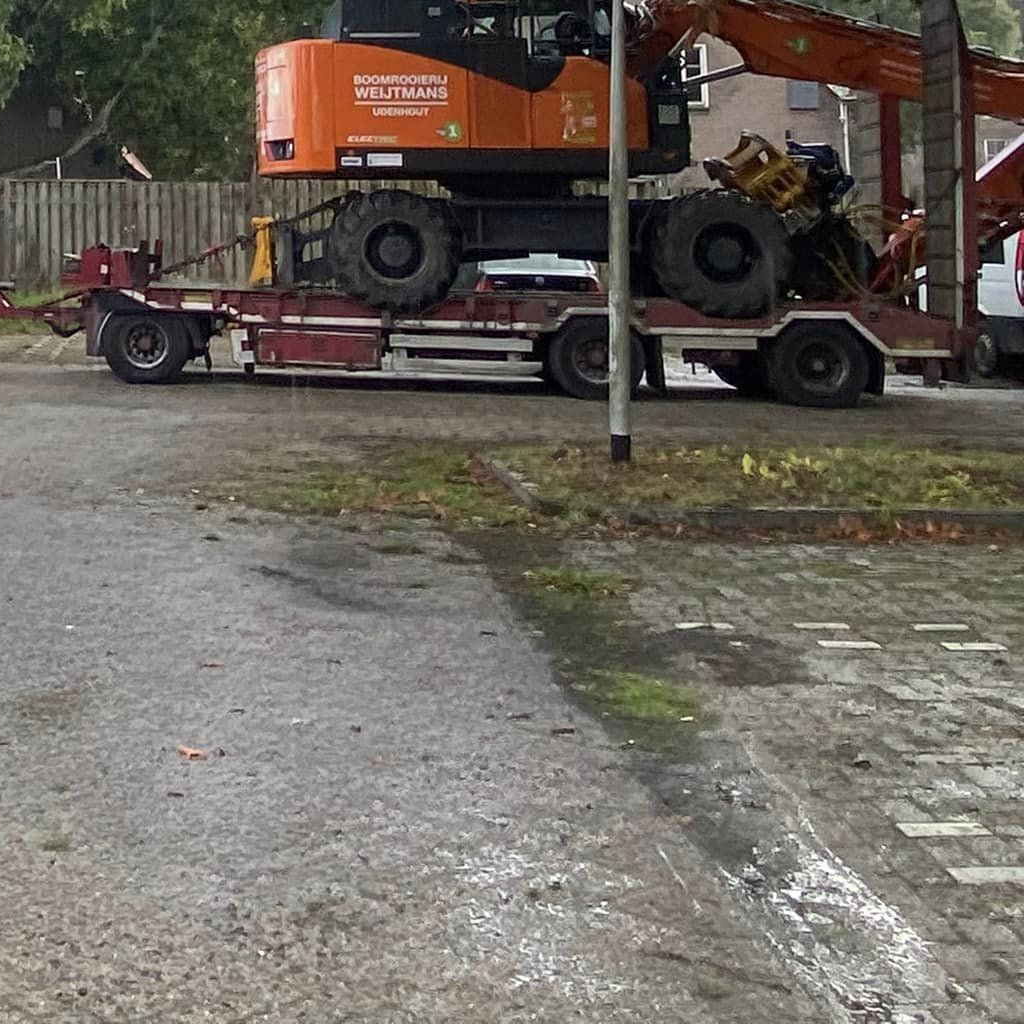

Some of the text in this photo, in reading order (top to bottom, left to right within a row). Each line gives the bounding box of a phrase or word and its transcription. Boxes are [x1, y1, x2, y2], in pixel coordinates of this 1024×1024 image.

[353, 74, 448, 86] BOOMROOIERIJ
[354, 86, 448, 99] WEIJTMANS
[372, 107, 430, 117] UDENHOUT
[448, 125, 457, 137] 1
